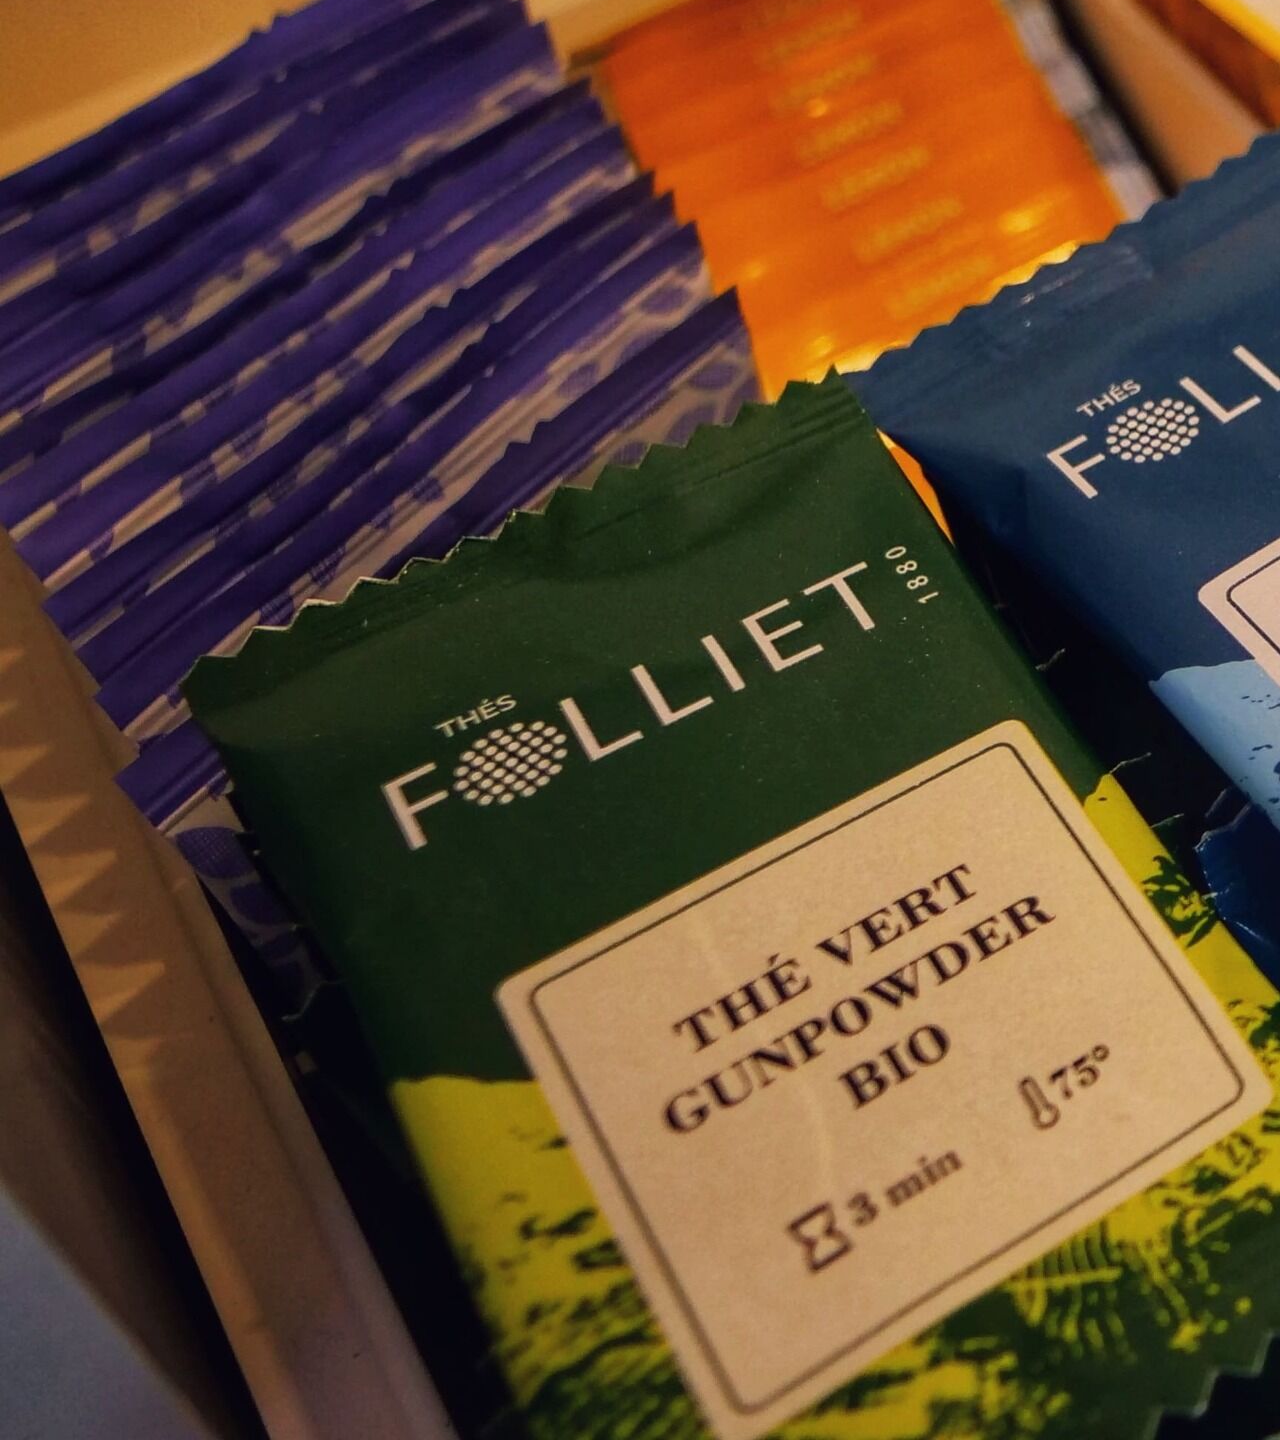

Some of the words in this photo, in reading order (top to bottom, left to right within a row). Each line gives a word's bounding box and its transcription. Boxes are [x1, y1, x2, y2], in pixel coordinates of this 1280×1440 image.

[1075, 378, 1142, 420] THÉS
[884, 544, 941, 606] 1880
[380, 560, 877, 851] FOLLIET
[434, 694, 518, 739] THÉS
[661, 894, 1056, 1138] GUNPOWDER
[671, 953, 813, 1055] THÉ
[815, 863, 981, 969] VERT
[838, 1021, 953, 1111] BIO
[847, 1193, 879, 1229] 3
[885, 1147, 963, 1210] min
[1047, 1041, 1113, 1101] 75°
